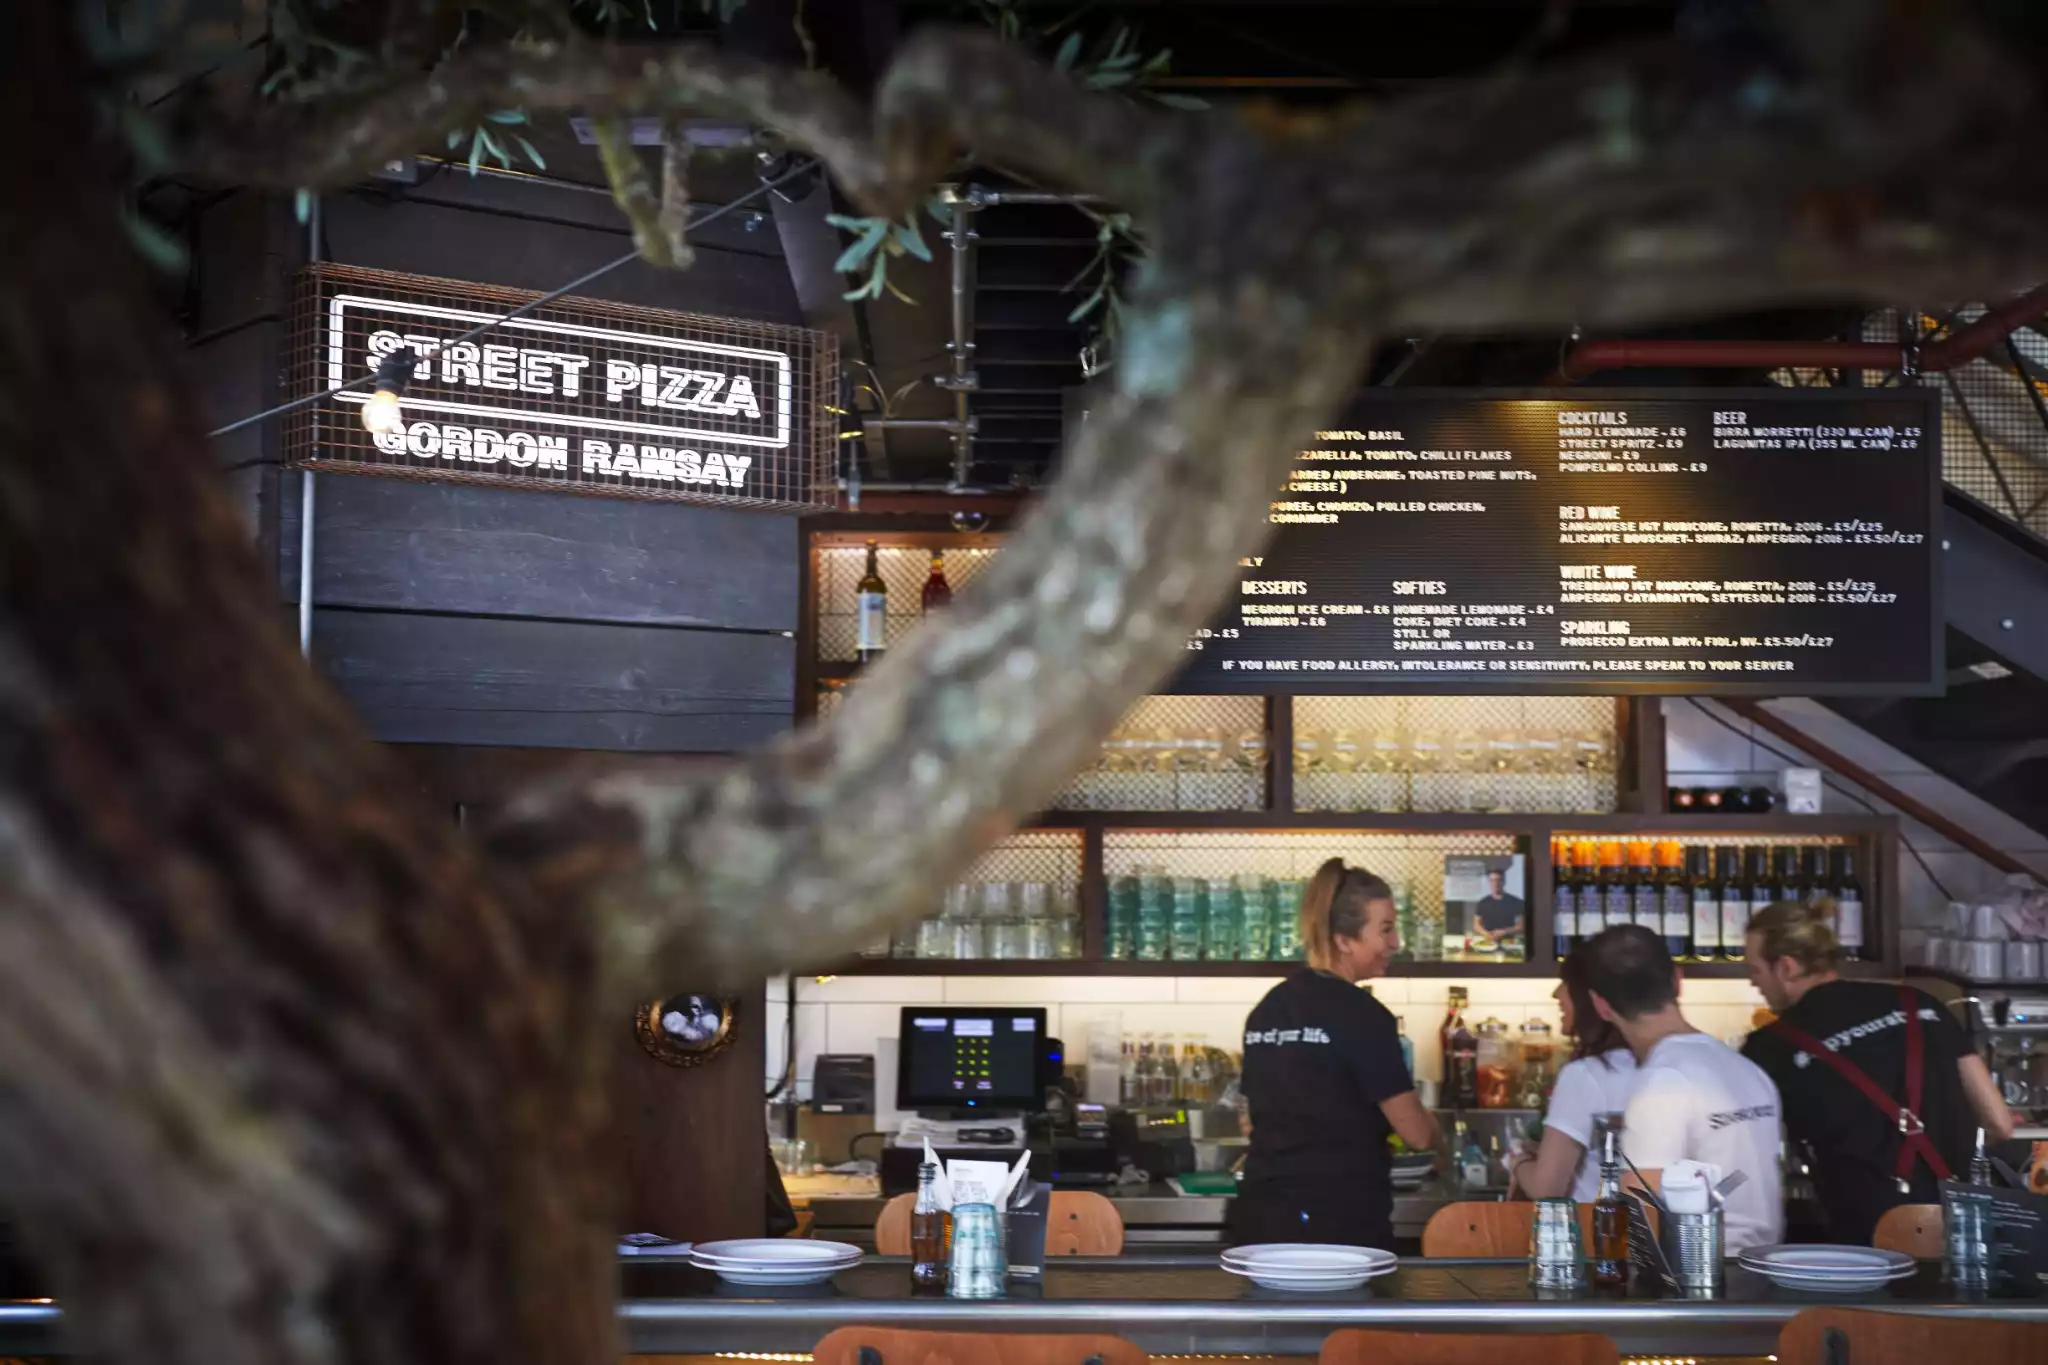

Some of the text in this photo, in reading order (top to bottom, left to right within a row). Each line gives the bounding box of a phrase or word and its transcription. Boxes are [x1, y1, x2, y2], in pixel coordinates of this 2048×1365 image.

[367, 331, 760, 418] STREET PIZZA
[1558, 411, 1628, 425] COCKTAILS
[1713, 411, 1747, 425] BEER
[1368, 431, 1405, 440] BASIL
[1558, 427, 1593, 437] HARD
[1594, 427, 1659, 437] LEMONADE
[1713, 427, 1751, 437] BIRRA
[1558, 439, 1608, 449] STREET
[1610, 439, 1656, 449] SPRITZ
[1713, 439, 1782, 449] LAGUNITAS
[1785, 439, 1806, 449] IPA
[373, 422, 751, 488] GORDON RAMSAY
[1364, 450, 1418, 460] TOMATO,
[1420, 450, 1461, 460] CHILLI
[1464, 450, 1512, 460] FLAKES
[1558, 451, 1612, 460] NEGRONI
[1558, 462, 1624, 472] POMPELMO
[1626, 462, 1679, 472] COLLINS
[1408, 470, 1466, 480] TOASTED
[1467, 470, 1497, 480] PINE
[1376, 502, 1426, 512] PULLED
[1559, 506, 1620, 520] RED WINE
[1269, 513, 1339, 524] CORIANDER
[1559, 522, 1637, 532] SANGIOVESE
[1559, 533, 1621, 544] ALICANTE
[1559, 565, 1637, 579] WHITE WINE
[1241, 581, 1307, 595] DESSERTS
[1393, 581, 1447, 595] SOFTIES
[1241, 605, 1295, 615] NEGRONI
[1297, 605, 1319, 615] ICE
[1321, 605, 1363, 615] CREAM
[1393, 605, 1458, 615] HOMEMADE
[1460, 605, 1526, 615] LEMONADE
[1536, 605, 1554, 615] £4
[1242, 617, 1299, 627] TIRAMISU
[1433, 617, 1462, 627] DIET
[1465, 617, 1498, 627] COKE
[1508, 617, 1526, 627] £4
[1560, 621, 1630, 635] SPARKLING
[1221, 629, 1240, 639] £5
[1393, 629, 1451, 639] STILL OR
[1393, 641, 1463, 650] SPARKLING
[1464, 641, 1507, 650] WATER
[1560, 637, 1626, 647] PROSECCO
[1628, 637, 1669, 647] EXTRA
[1222, 660, 1235, 670] IF
[1238, 660, 1263, 670] YOU
[1265, 660, 1300, 670] HAVE
[1302, 660, 1336, 670] FOOD
[1401, 660, 1487, 670] INTOLERANCE
[1489, 660, 1507, 670] OR
[1592, 661, 1642, 671] PLEASE
[1644, 661, 1686, 671] SPEAK
[1688, 661, 1707, 671] TO
[1709, 661, 1742, 671] YOUR
[1745, 661, 1795, 671] SERVER
